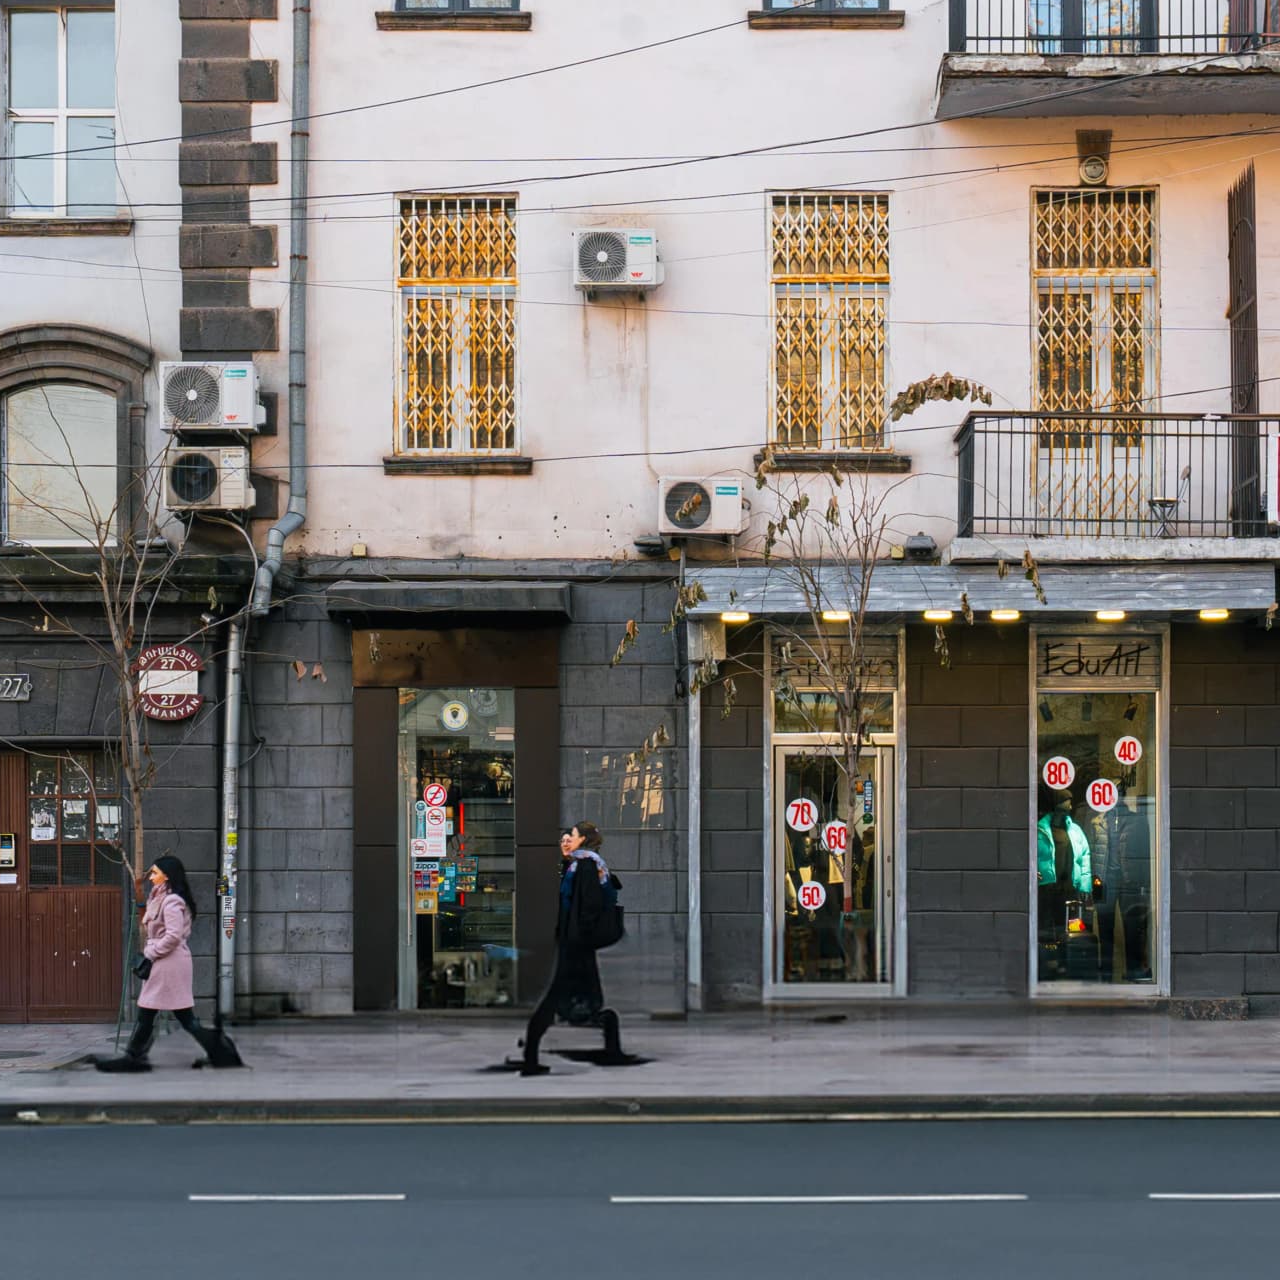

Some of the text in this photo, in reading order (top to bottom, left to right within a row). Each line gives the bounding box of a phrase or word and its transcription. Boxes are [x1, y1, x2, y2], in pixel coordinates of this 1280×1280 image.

[160, 659, 175, 669] 27
[1043, 643, 1151, 676] EduArt
[2, 678, 23, 697] 27
[160, 695, 176, 706] 27
